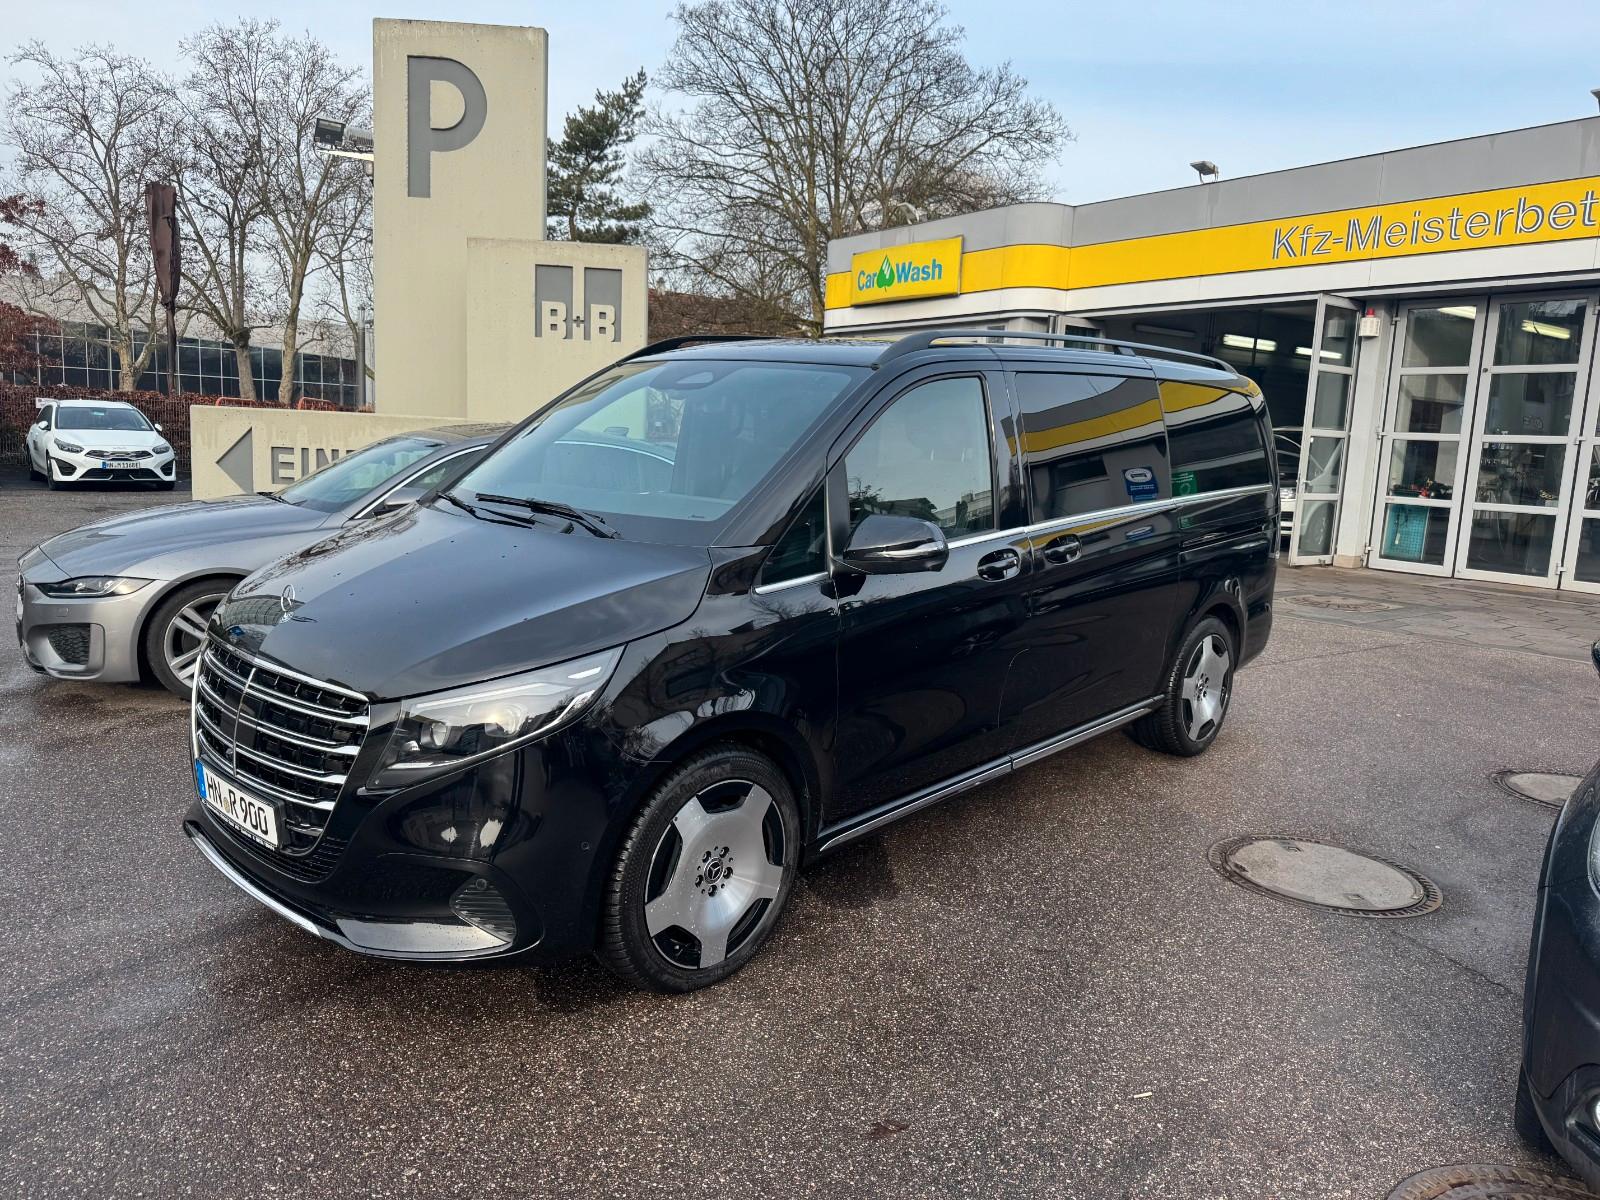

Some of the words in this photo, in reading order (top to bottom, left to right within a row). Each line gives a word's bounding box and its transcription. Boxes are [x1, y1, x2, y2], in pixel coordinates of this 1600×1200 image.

[407, 55, 488, 198] P
[1271, 190, 1600, 260] Kfz-Meisterbet
[857, 270, 877, 291] Car
[896, 258, 943, 284] Wash
[271, 446, 357, 485] EI
[205, 772, 223, 808] HN
[228, 788, 240, 820] R
[240, 796, 269, 836] 900
